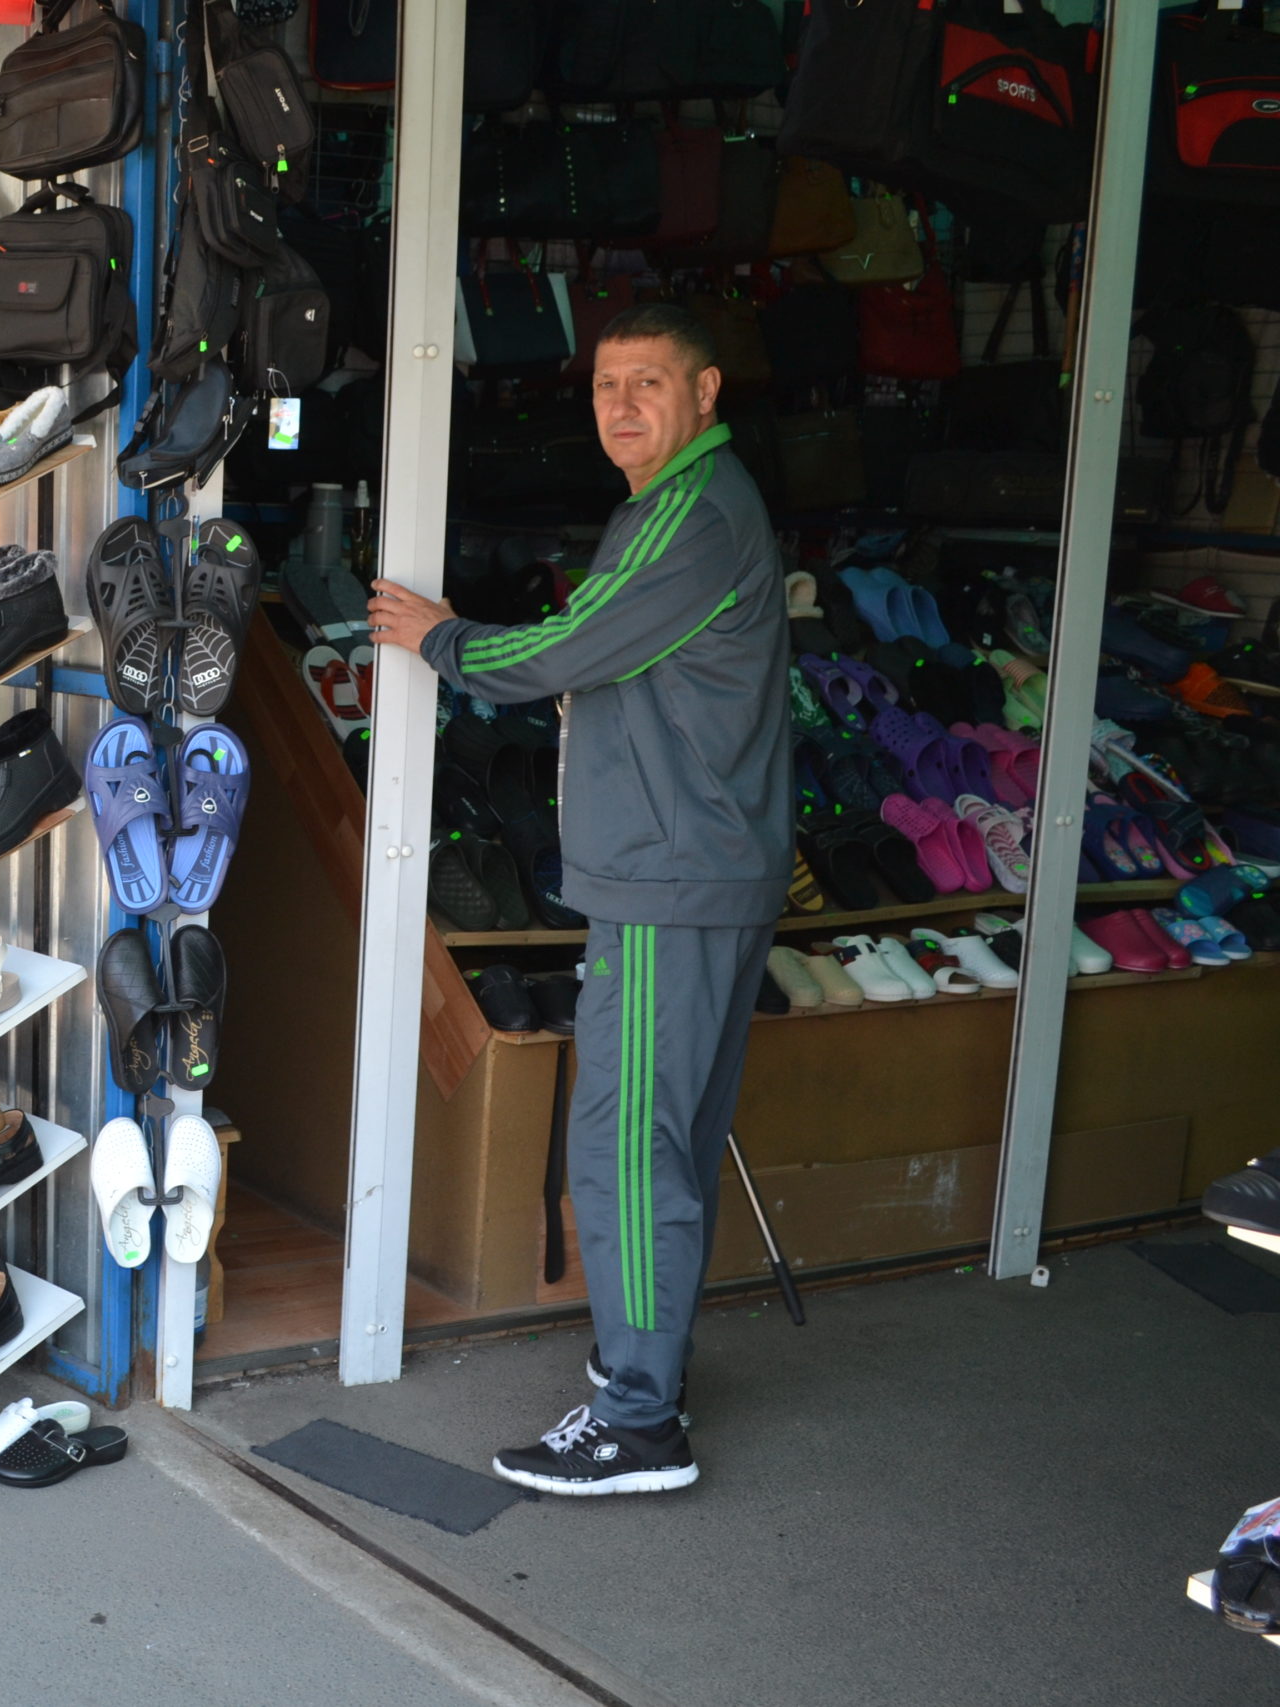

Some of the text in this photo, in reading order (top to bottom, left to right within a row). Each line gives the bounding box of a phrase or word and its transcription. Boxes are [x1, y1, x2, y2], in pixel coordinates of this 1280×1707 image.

[997, 78, 1036, 102] SPORTS
[200, 835, 218, 872] fashion
[180, 1010, 209, 1082] Angela
